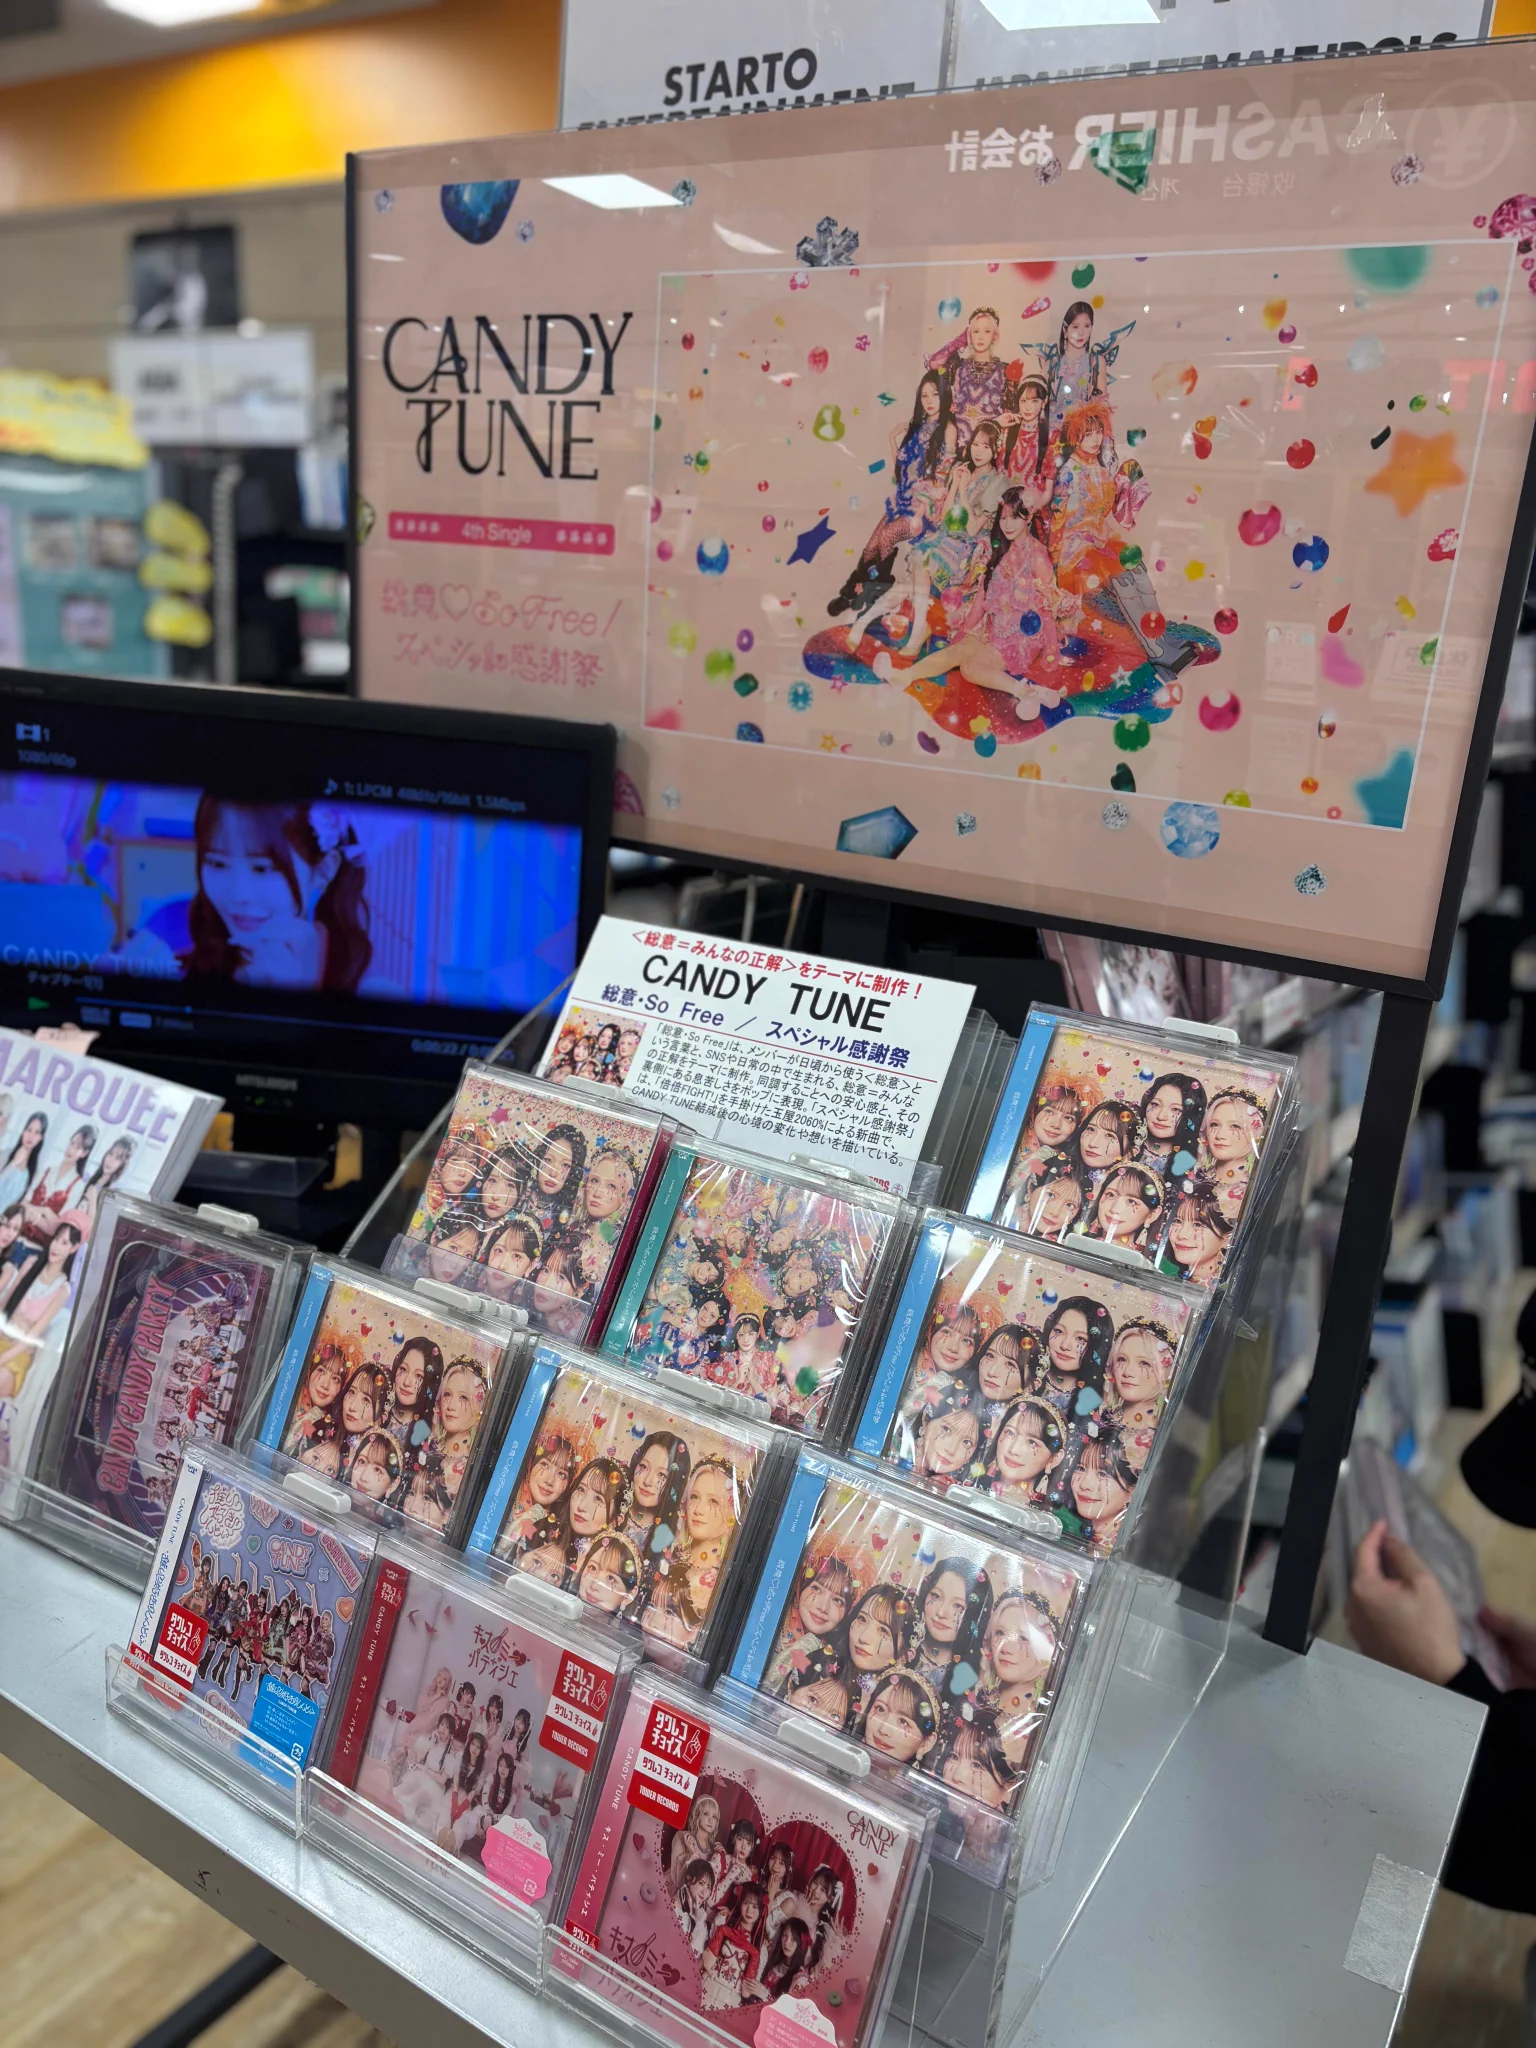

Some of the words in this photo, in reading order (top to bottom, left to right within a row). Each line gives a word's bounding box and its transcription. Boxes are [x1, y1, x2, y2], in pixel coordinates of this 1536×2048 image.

[663, 47, 817, 106] STARTO
[382, 311, 633, 396] CANDY
[404, 398, 601, 480] TUNE
[462, 521, 485, 540] 4th
[487, 523, 532, 546] Single
[642, 954, 768, 1005] CANDY
[789, 983, 891, 1033] TUNE
[680, 1002, 725, 1027] Free
[765, 1019, 911, 1069] スペシャル感謝祭
[641, 1060, 915, 1139] 裏側にある息苦しさをポップに表現。「スペシャル感謝祭」
[647, 1048, 920, 1124] の正解をテーマに制作。同調することへの安心感と、その
[136, 1274, 176, 1354] PARTY
[116, 1352, 157, 1424] CANDY
[98, 1421, 139, 1494] CANDY
[172, 1496, 186, 1525] CANDY
[167, 1524, 178, 1544] TUNE
[270, 1538, 313, 1558] CANDY
[273, 1552, 306, 1573] TUNE
[169, 1612, 193, 1638] タワレコ
[372, 1605, 387, 1635] CANDY
[167, 1626, 188, 1652] チョイス
[365, 1638, 378, 1661] TUNE
[159, 1649, 174, 1665] タワレコ
[173, 1659, 188, 1677] チョイス
[468, 1648, 519, 1689] パティシエ
[565, 1660, 596, 1691] タワレコ
[562, 1677, 590, 1707] チョイス
[554, 1703, 574, 1721] タワレコ
[573, 1713, 592, 1735] チョイス
[656, 1710, 689, 1742] タワレコ
[551, 1730, 568, 1746] TOWER
[568, 1738, 589, 1758] RECORDS
[651, 1727, 683, 1759] チョイス
[618, 1746, 635, 1780] CANDY
[642, 1756, 663, 1776] タワレコ
[664, 1767, 684, 1786] チョイス
[610, 1783, 624, 1810] TUNE
[639, 1785, 656, 1801] TOWER
[656, 1793, 680, 1813] RECORDS
[846, 1810, 900, 1847] CANDY
[851, 1826, 890, 1860] TUNE
[572, 1926, 590, 1944] タワレコ
